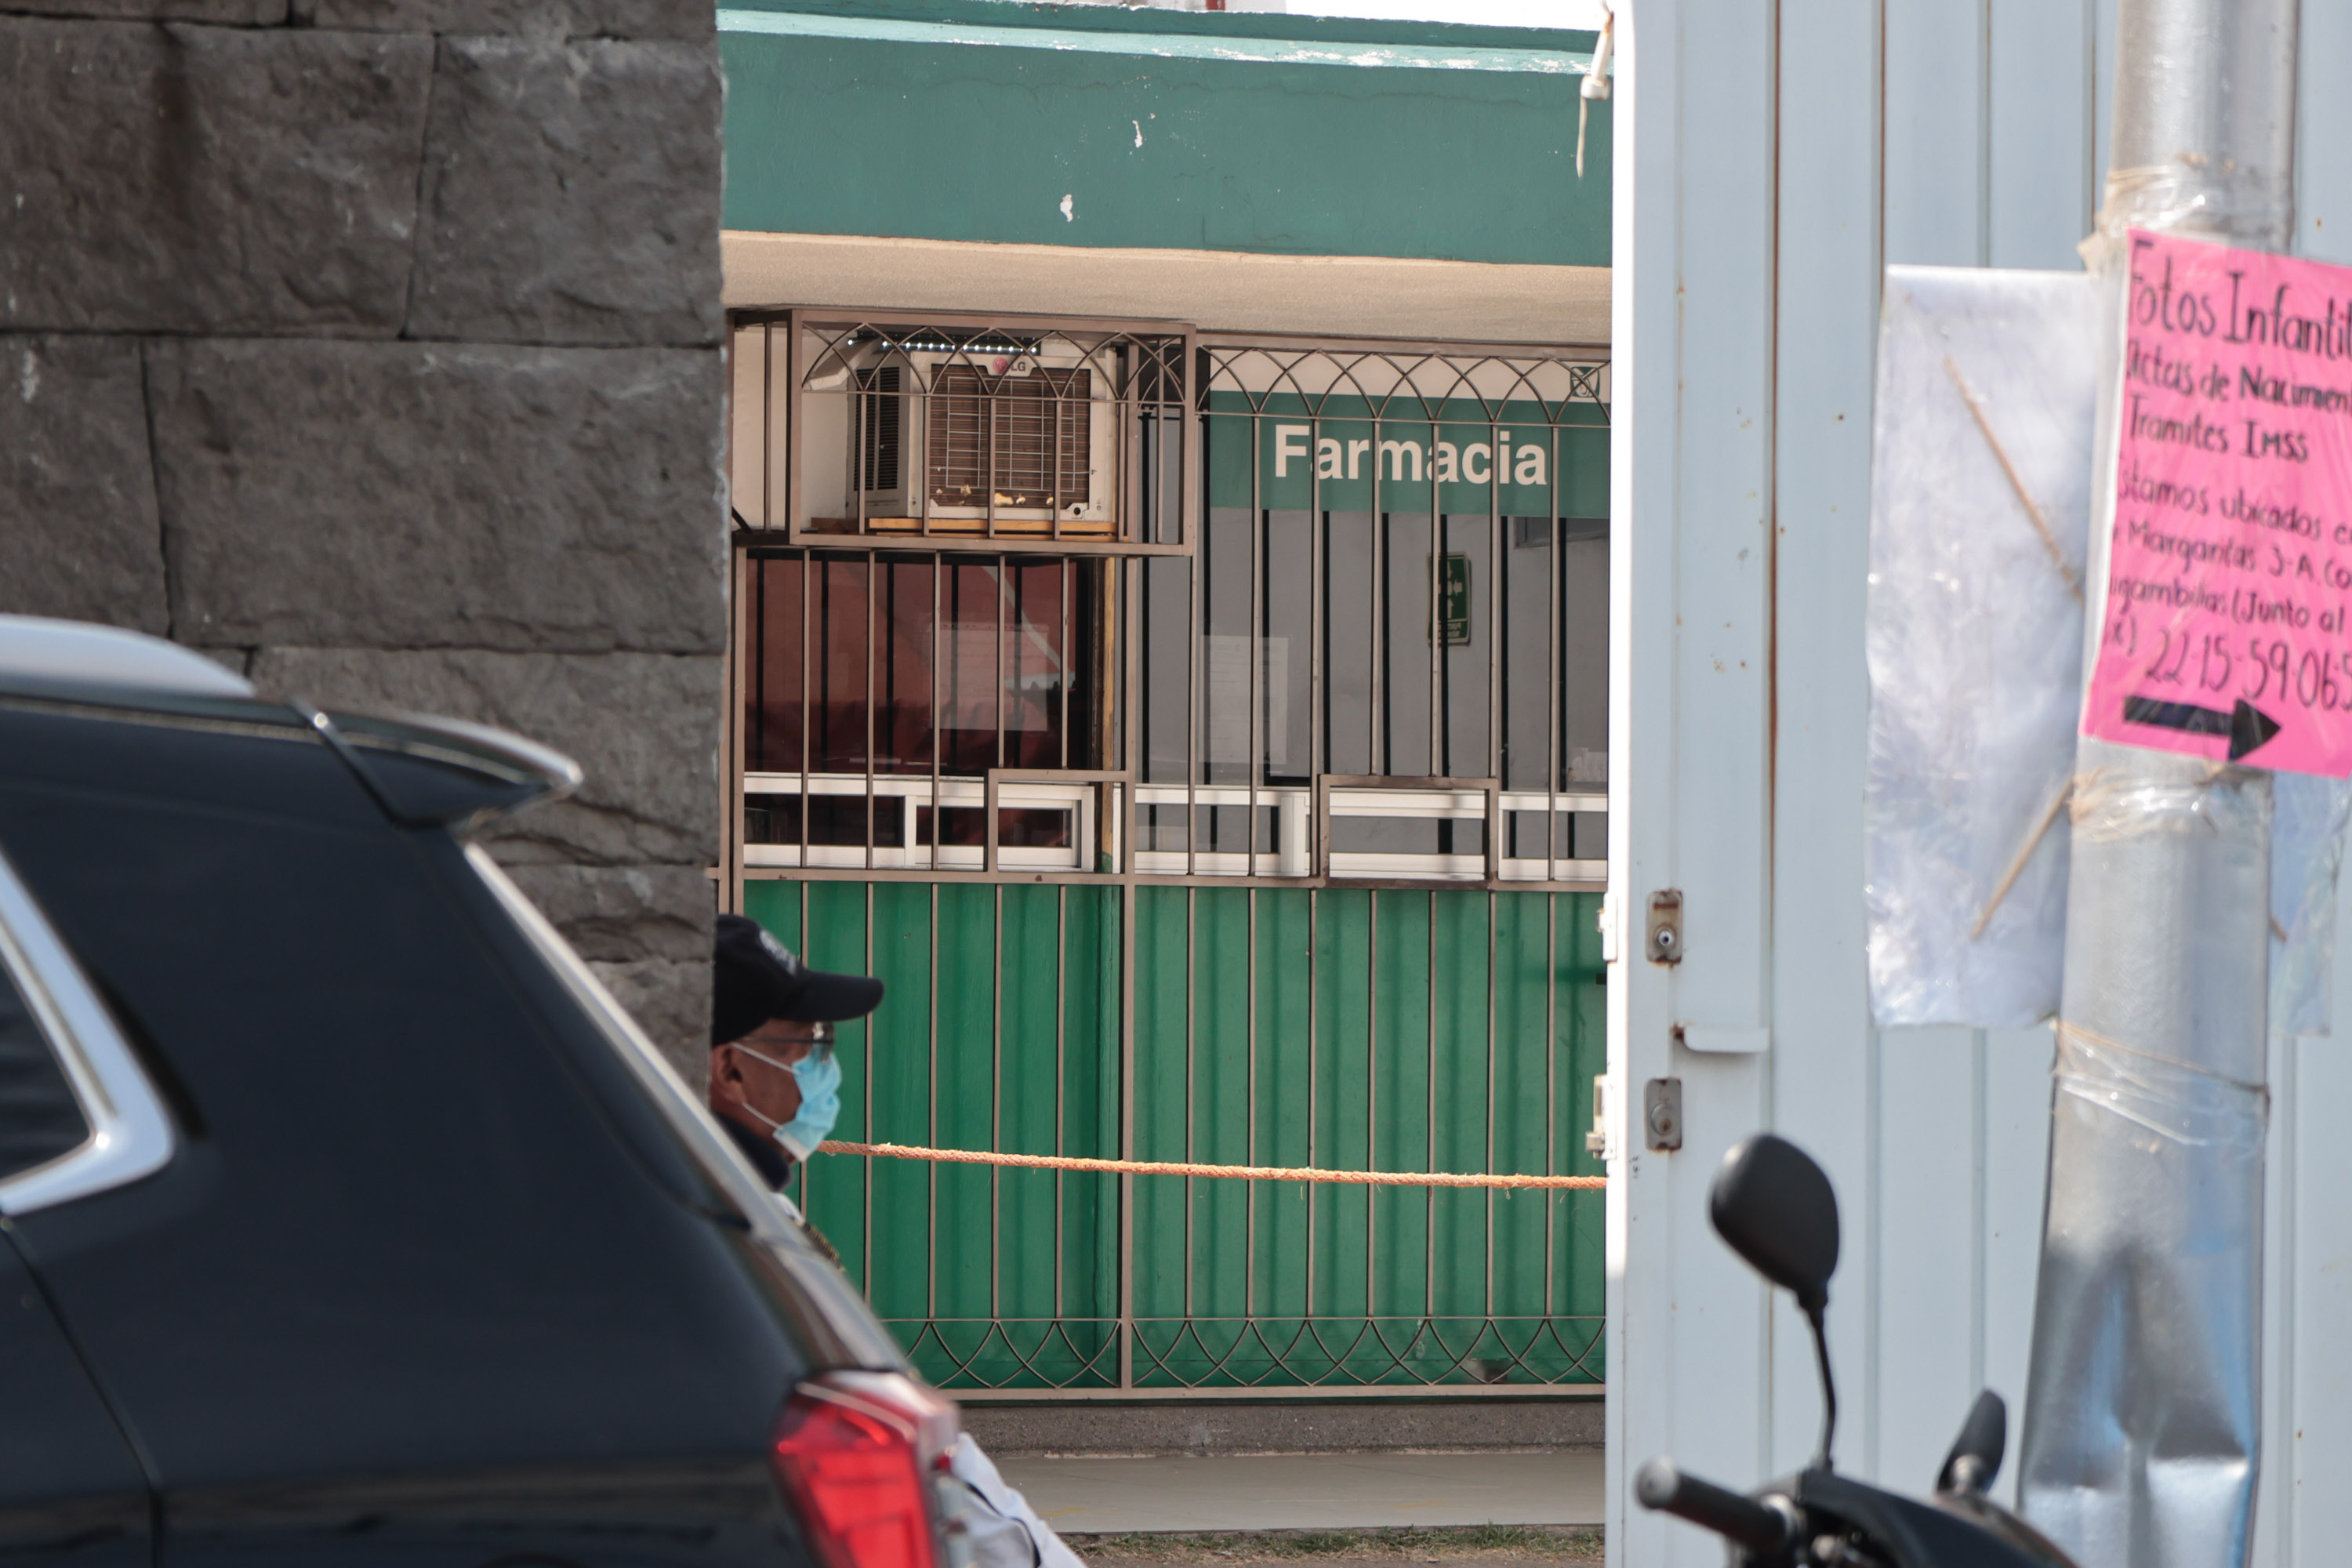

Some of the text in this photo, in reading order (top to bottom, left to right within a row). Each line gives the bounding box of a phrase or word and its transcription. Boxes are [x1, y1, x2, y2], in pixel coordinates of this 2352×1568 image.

[1011, 361, 1026, 372] LG
[2200, 361, 2230, 403] de
[2239, 364, 2352, 419] Nacimien
[1274, 424, 1548, 485] Farmacia
[2240, 419, 2309, 465] IMSS
[2118, 453, 2209, 517] stamos
[2220, 487, 2321, 542] ubicados
[2318, 604, 2345, 635] al
